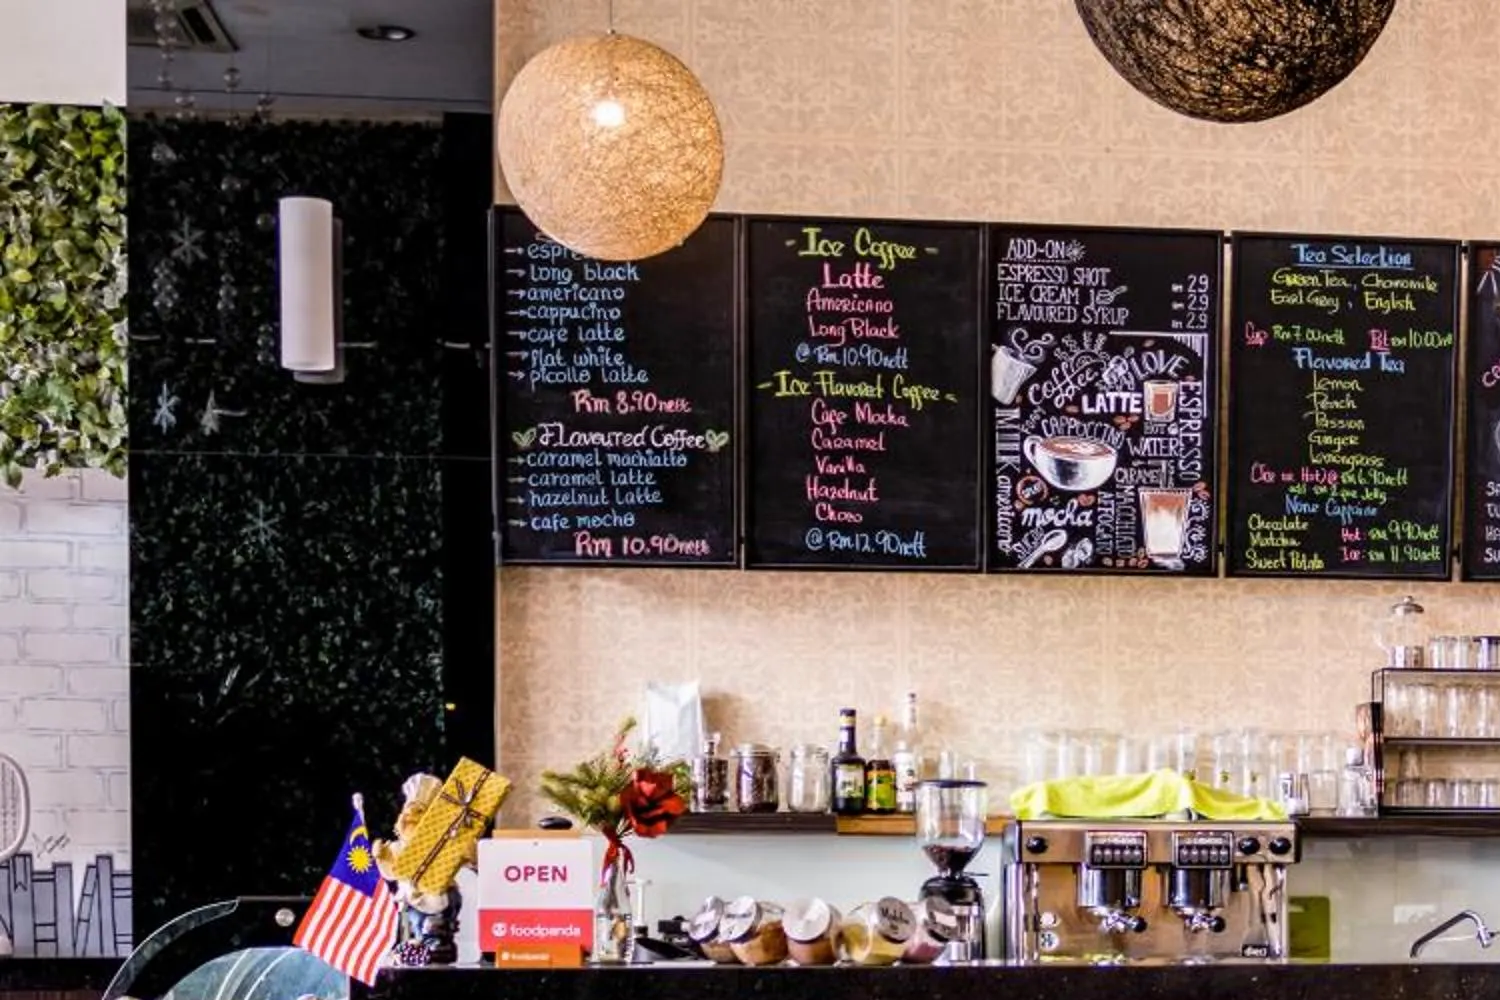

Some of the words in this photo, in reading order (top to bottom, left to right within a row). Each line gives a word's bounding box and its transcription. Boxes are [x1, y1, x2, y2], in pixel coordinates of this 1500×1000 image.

[798, 227, 845, 257] Ice
[1006, 238, 1066, 260] ADD-ON
[1290, 243, 1326, 263] Tea
[1331, 245, 1412, 266] Selection
[530, 263, 573, 285] long
[584, 262, 641, 281] black
[822, 261, 885, 289] Latte
[997, 263, 1068, 284] ESPRESSO
[1073, 267, 1111, 286] SHOT
[527, 284, 625, 301] americano
[806, 287, 893, 313] Americano
[998, 283, 1025, 302] ICE
[1030, 285, 1079, 305] CREAM
[1364, 291, 1416, 314] English
[527, 302, 621, 325] cappucino
[996, 301, 1077, 323] FLAVOURED
[1081, 306, 1129, 326] SYRUP
[527, 328, 568, 347] cafe
[578, 324, 626, 341] latte
[808, 315, 847, 347] Long
[842, 317, 900, 339] Black
[531, 348, 565, 367] flat
[573, 346, 625, 366] white
[1130, 349, 1189, 380] LOVE
[1378, 351, 1405, 374] Tea
[601, 366, 649, 383] latte
[773, 371, 811, 397] Ice
[1313, 370, 1364, 392] Lemon
[1082, 391, 1143, 414] LATTE
[1305, 391, 1357, 411] Peach
[811, 398, 848, 434] Cafe
[855, 401, 909, 427] Mocha
[1302, 411, 1365, 431] Passion
[538, 421, 648, 447] Flavoured
[650, 425, 706, 450] Coffee
[811, 427, 886, 451] Caramel
[995, 408, 1021, 473] MILK
[1179, 381, 1202, 481] ESPRESSO
[527, 449, 602, 467] caramel
[1126, 436, 1179, 457] WATER
[815, 455, 865, 474] Vanilla
[528, 470, 603, 487] caramel
[611, 469, 657, 486] latte
[806, 474, 880, 501] Hazelnut
[529, 489, 608, 507] hazelnut
[615, 487, 663, 503] latte
[1285, 494, 1319, 515] None
[531, 513, 570, 532] cafe
[577, 509, 636, 527] mocha
[1021, 499, 1093, 527] mocha
[504, 865, 568, 882] OPEN
[510, 922, 581, 938] foodpanda
